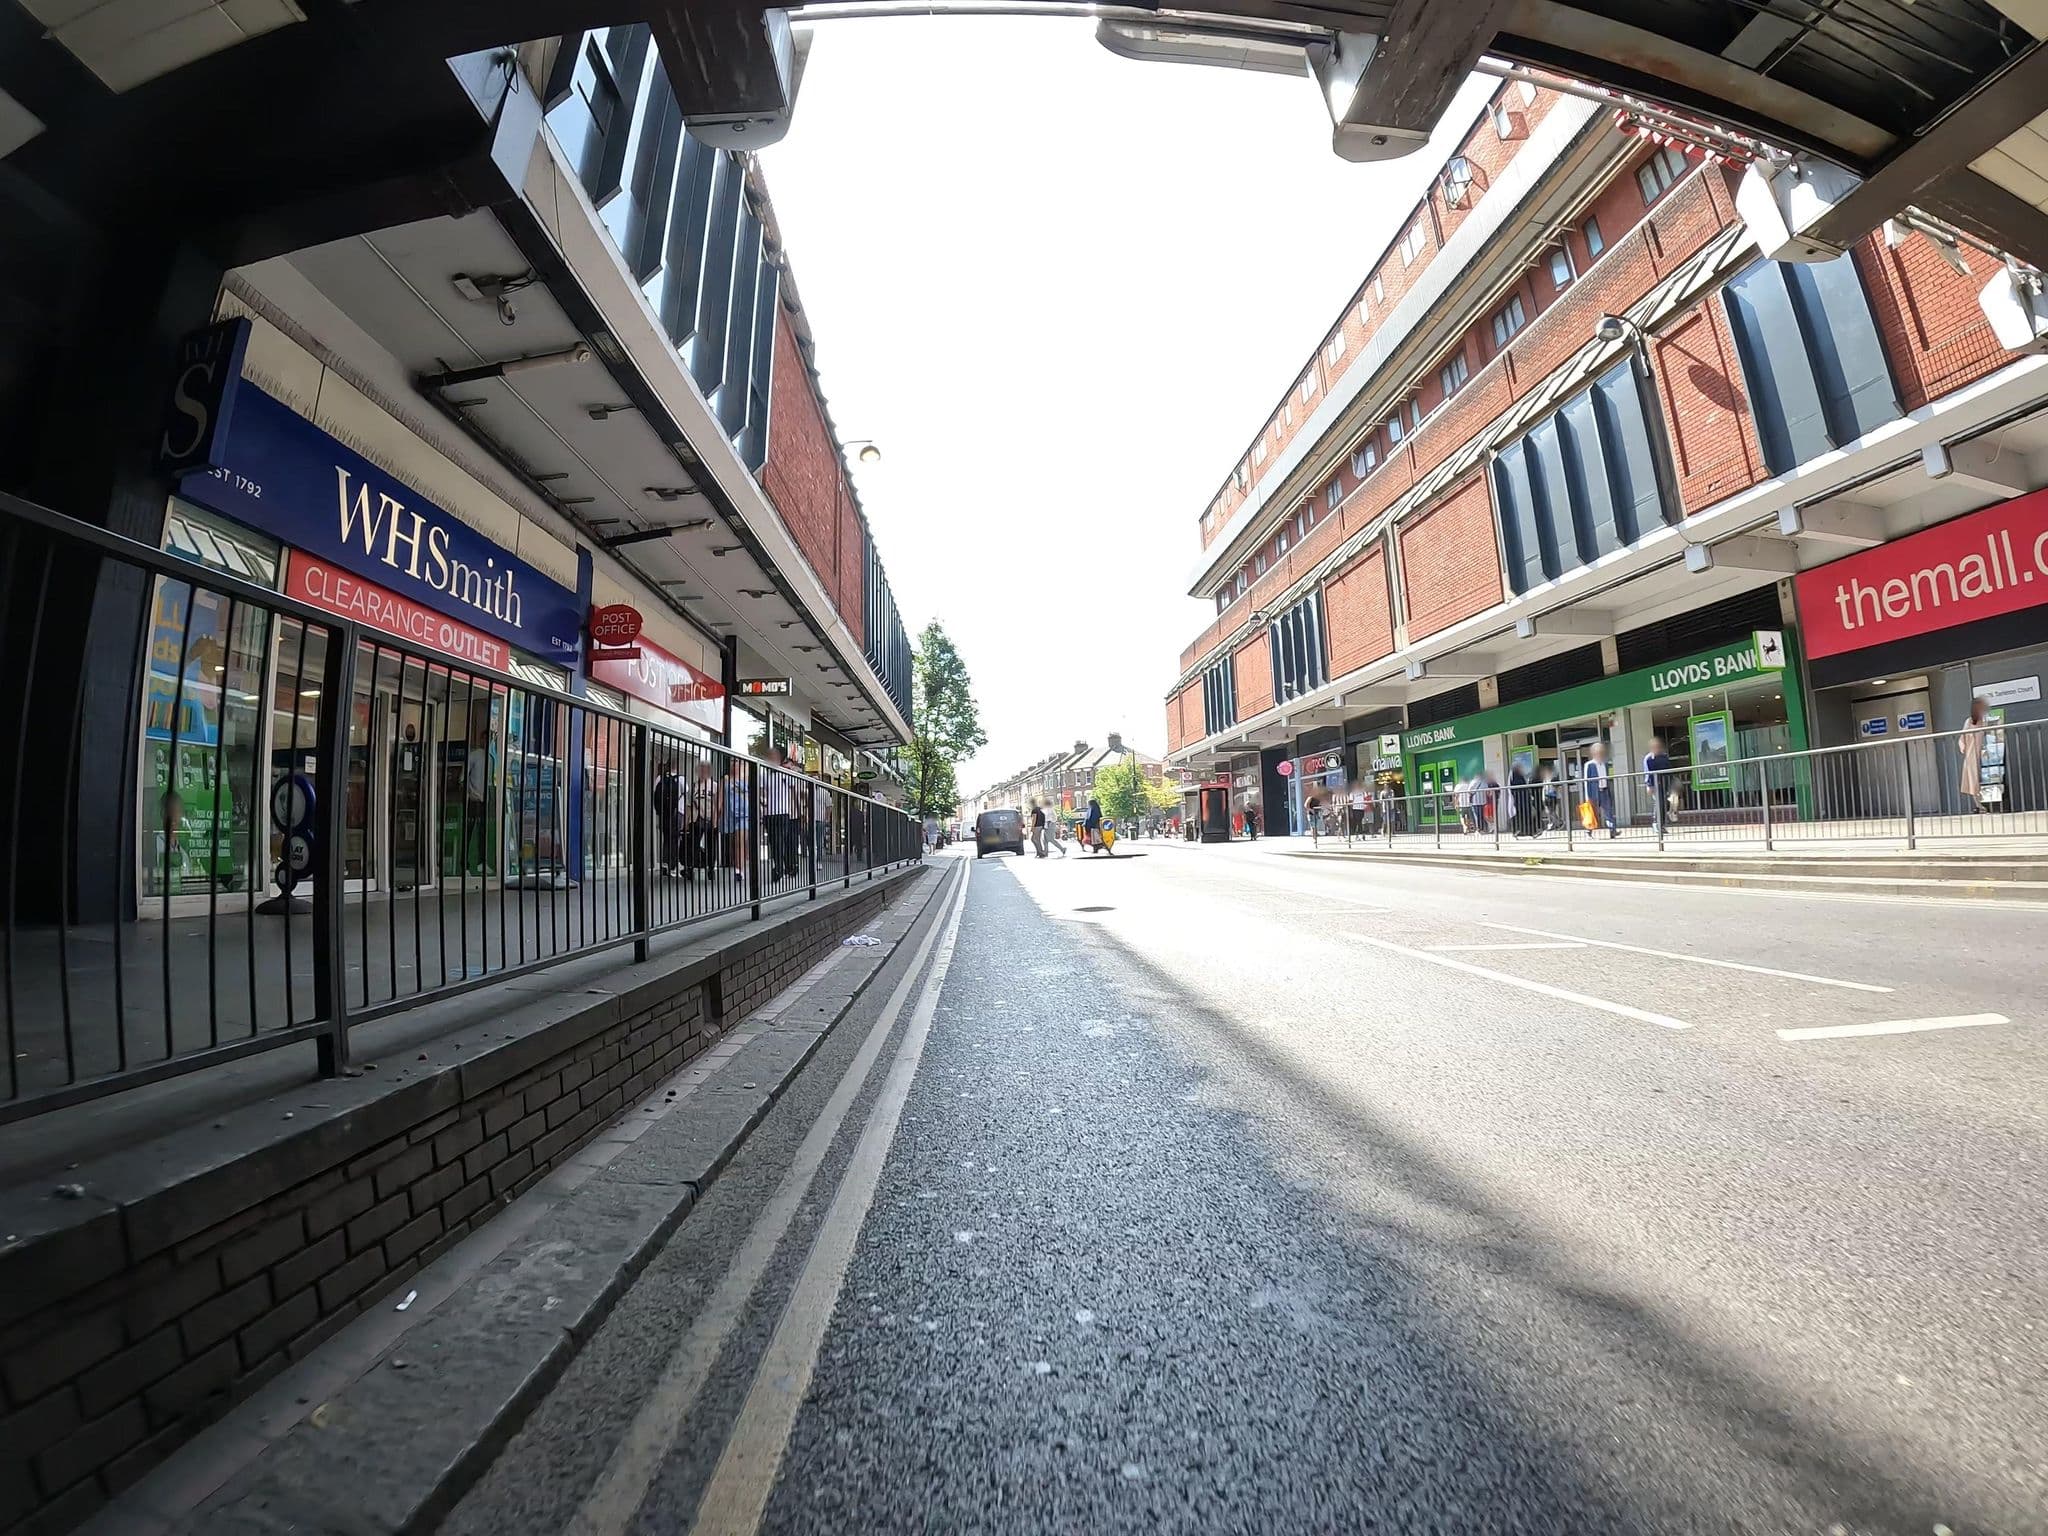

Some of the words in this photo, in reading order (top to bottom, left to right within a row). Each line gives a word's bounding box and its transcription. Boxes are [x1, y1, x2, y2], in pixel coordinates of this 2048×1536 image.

[235, 475, 262, 499] 1792
[334, 464, 524, 629] WHSmith
[304, 566, 435, 643] CLEARANCE
[438, 624, 502, 666] OUTLET
[602, 611, 632, 624] POST
[551, 635, 562, 647] EST
[594, 623, 637, 637] OFFICE
[627, 650, 664, 690] POST
[1651, 660, 1711, 693] LLOYDS
[742, 679, 788, 694] MOMO'S
[1406, 731, 1434, 748] LLOYDS
[1434, 725, 1456, 742] BANK
